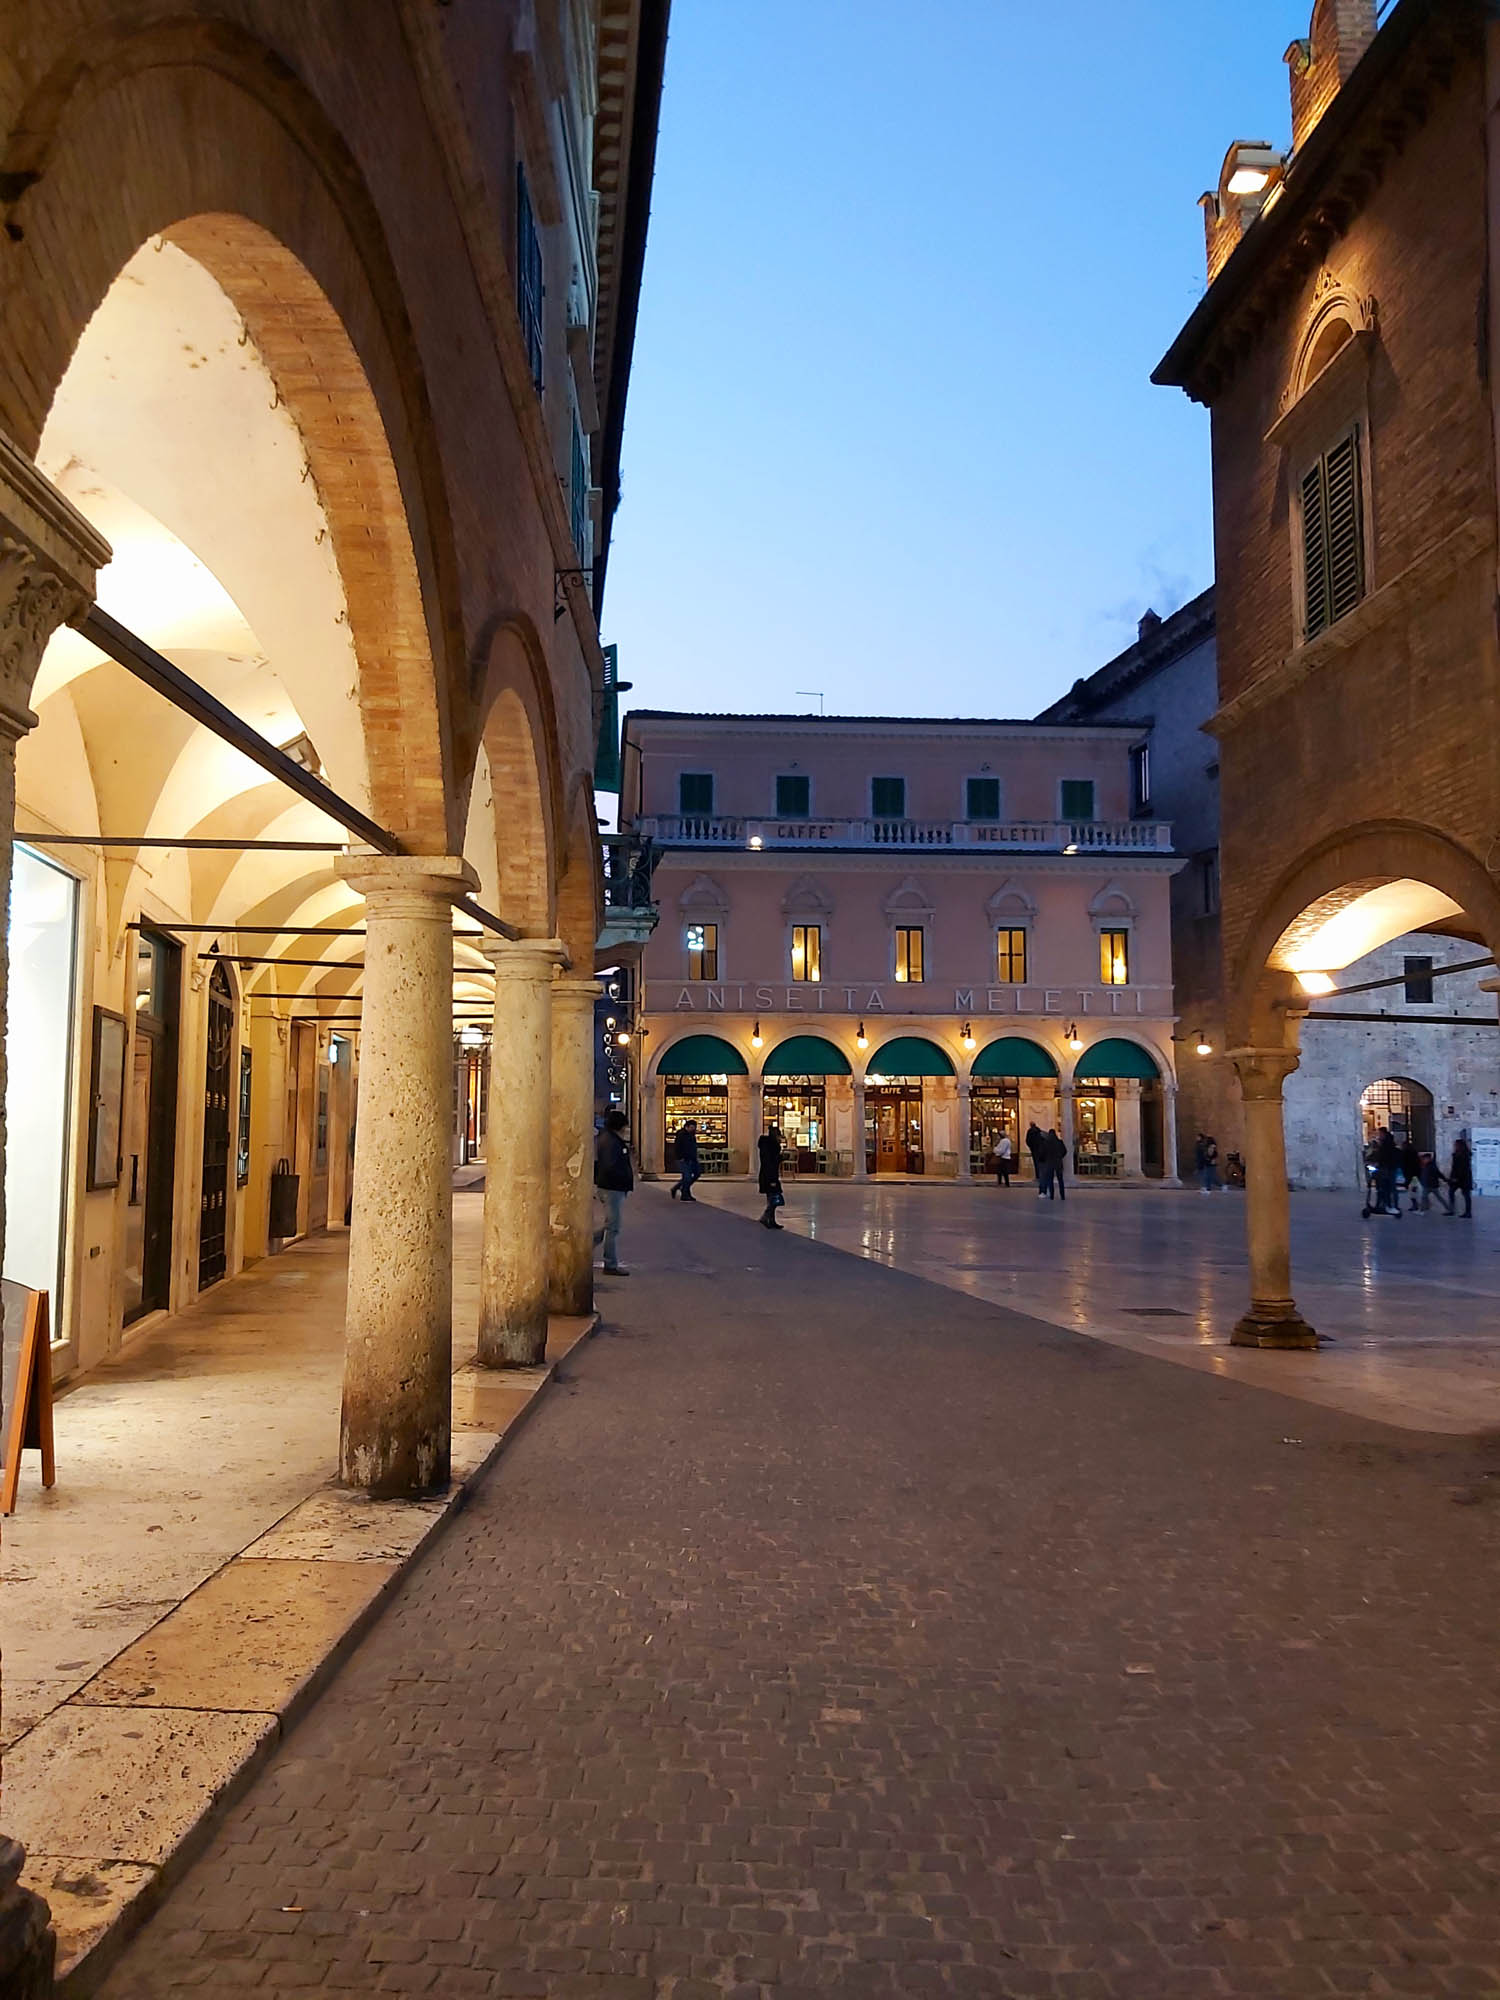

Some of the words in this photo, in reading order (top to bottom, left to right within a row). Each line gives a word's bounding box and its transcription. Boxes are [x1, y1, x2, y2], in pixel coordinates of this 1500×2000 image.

[977, 827, 1046, 842] MELETTI
[675, 986, 885, 1010] ANISETTA
[953, 989, 1145, 1013] MELETTI
